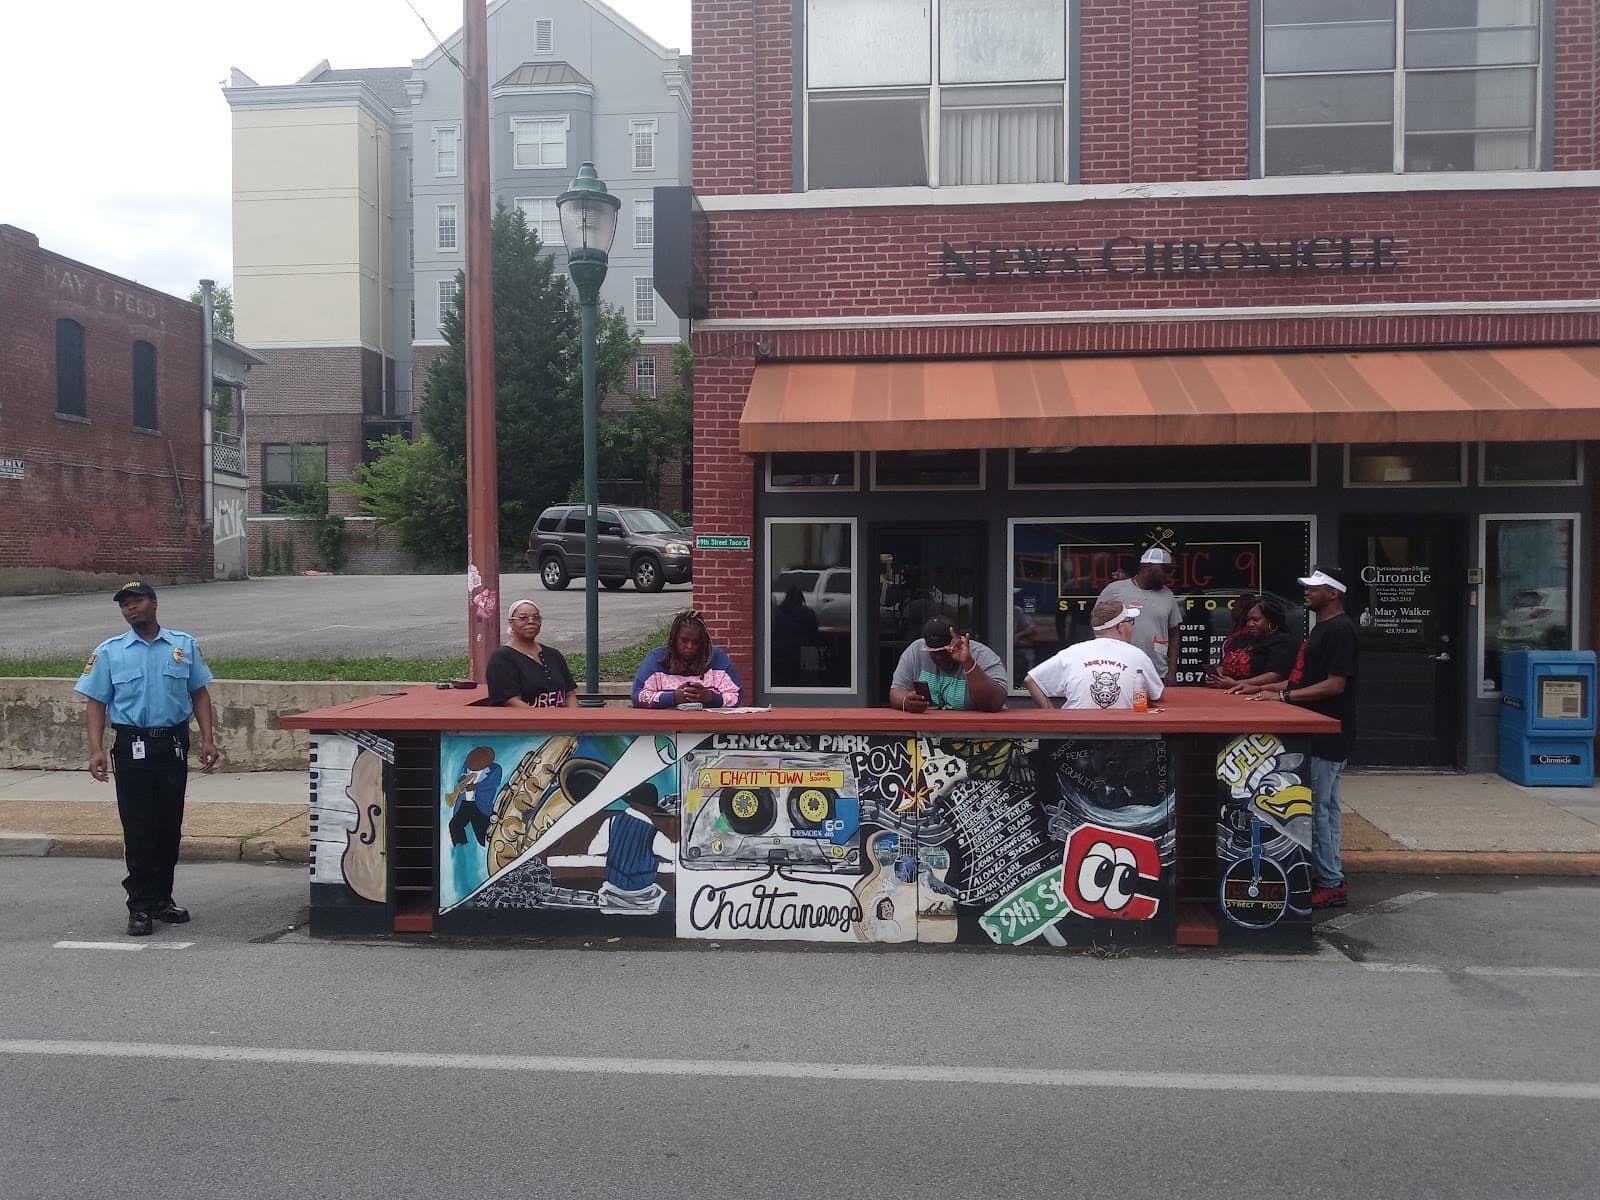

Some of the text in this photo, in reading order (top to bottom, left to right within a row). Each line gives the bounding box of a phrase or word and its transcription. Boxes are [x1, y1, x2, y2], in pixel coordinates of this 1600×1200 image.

[1102, 236, 1401, 276] CHRONICLE
[1067, 551, 1134, 592] THE
[1235, 551, 1257, 586] 9
[1360, 565, 1431, 583] Chronicle
[1374, 607, 1431, 618] Mary Walker
[818, 735, 870, 752] PARK
[1066, 750, 1089, 760] PEACE
[1156, 740, 1167, 761] DEC
[1217, 733, 1276, 784] UTC
[702, 773, 711, 785] A
[1060, 762, 1099, 792] EQUALITY
[960, 788, 1001, 823] ERIC GARNER
[990, 792, 1010, 810] FLOYD
[825, 820, 845, 832] 60
[968, 802, 1011, 836] TAMIR RICE
[972, 800, 1032, 847] BREONNA TAYLOR
[974, 814, 1032, 858] SANDRA BLAND
[973, 837, 1041, 887] ALONZO SMITH
[975, 829, 1032, 872] JOHN CRAWFORD
[974, 860, 1023, 898] JAMAR CLARK
[985, 892, 999, 904] AND
[999, 876, 1020, 895] MANY
[690, 884, 863, 933] Chattanooga
[999, 896, 1041, 938] 9th
[1262, 902, 1283, 910] FOOD
